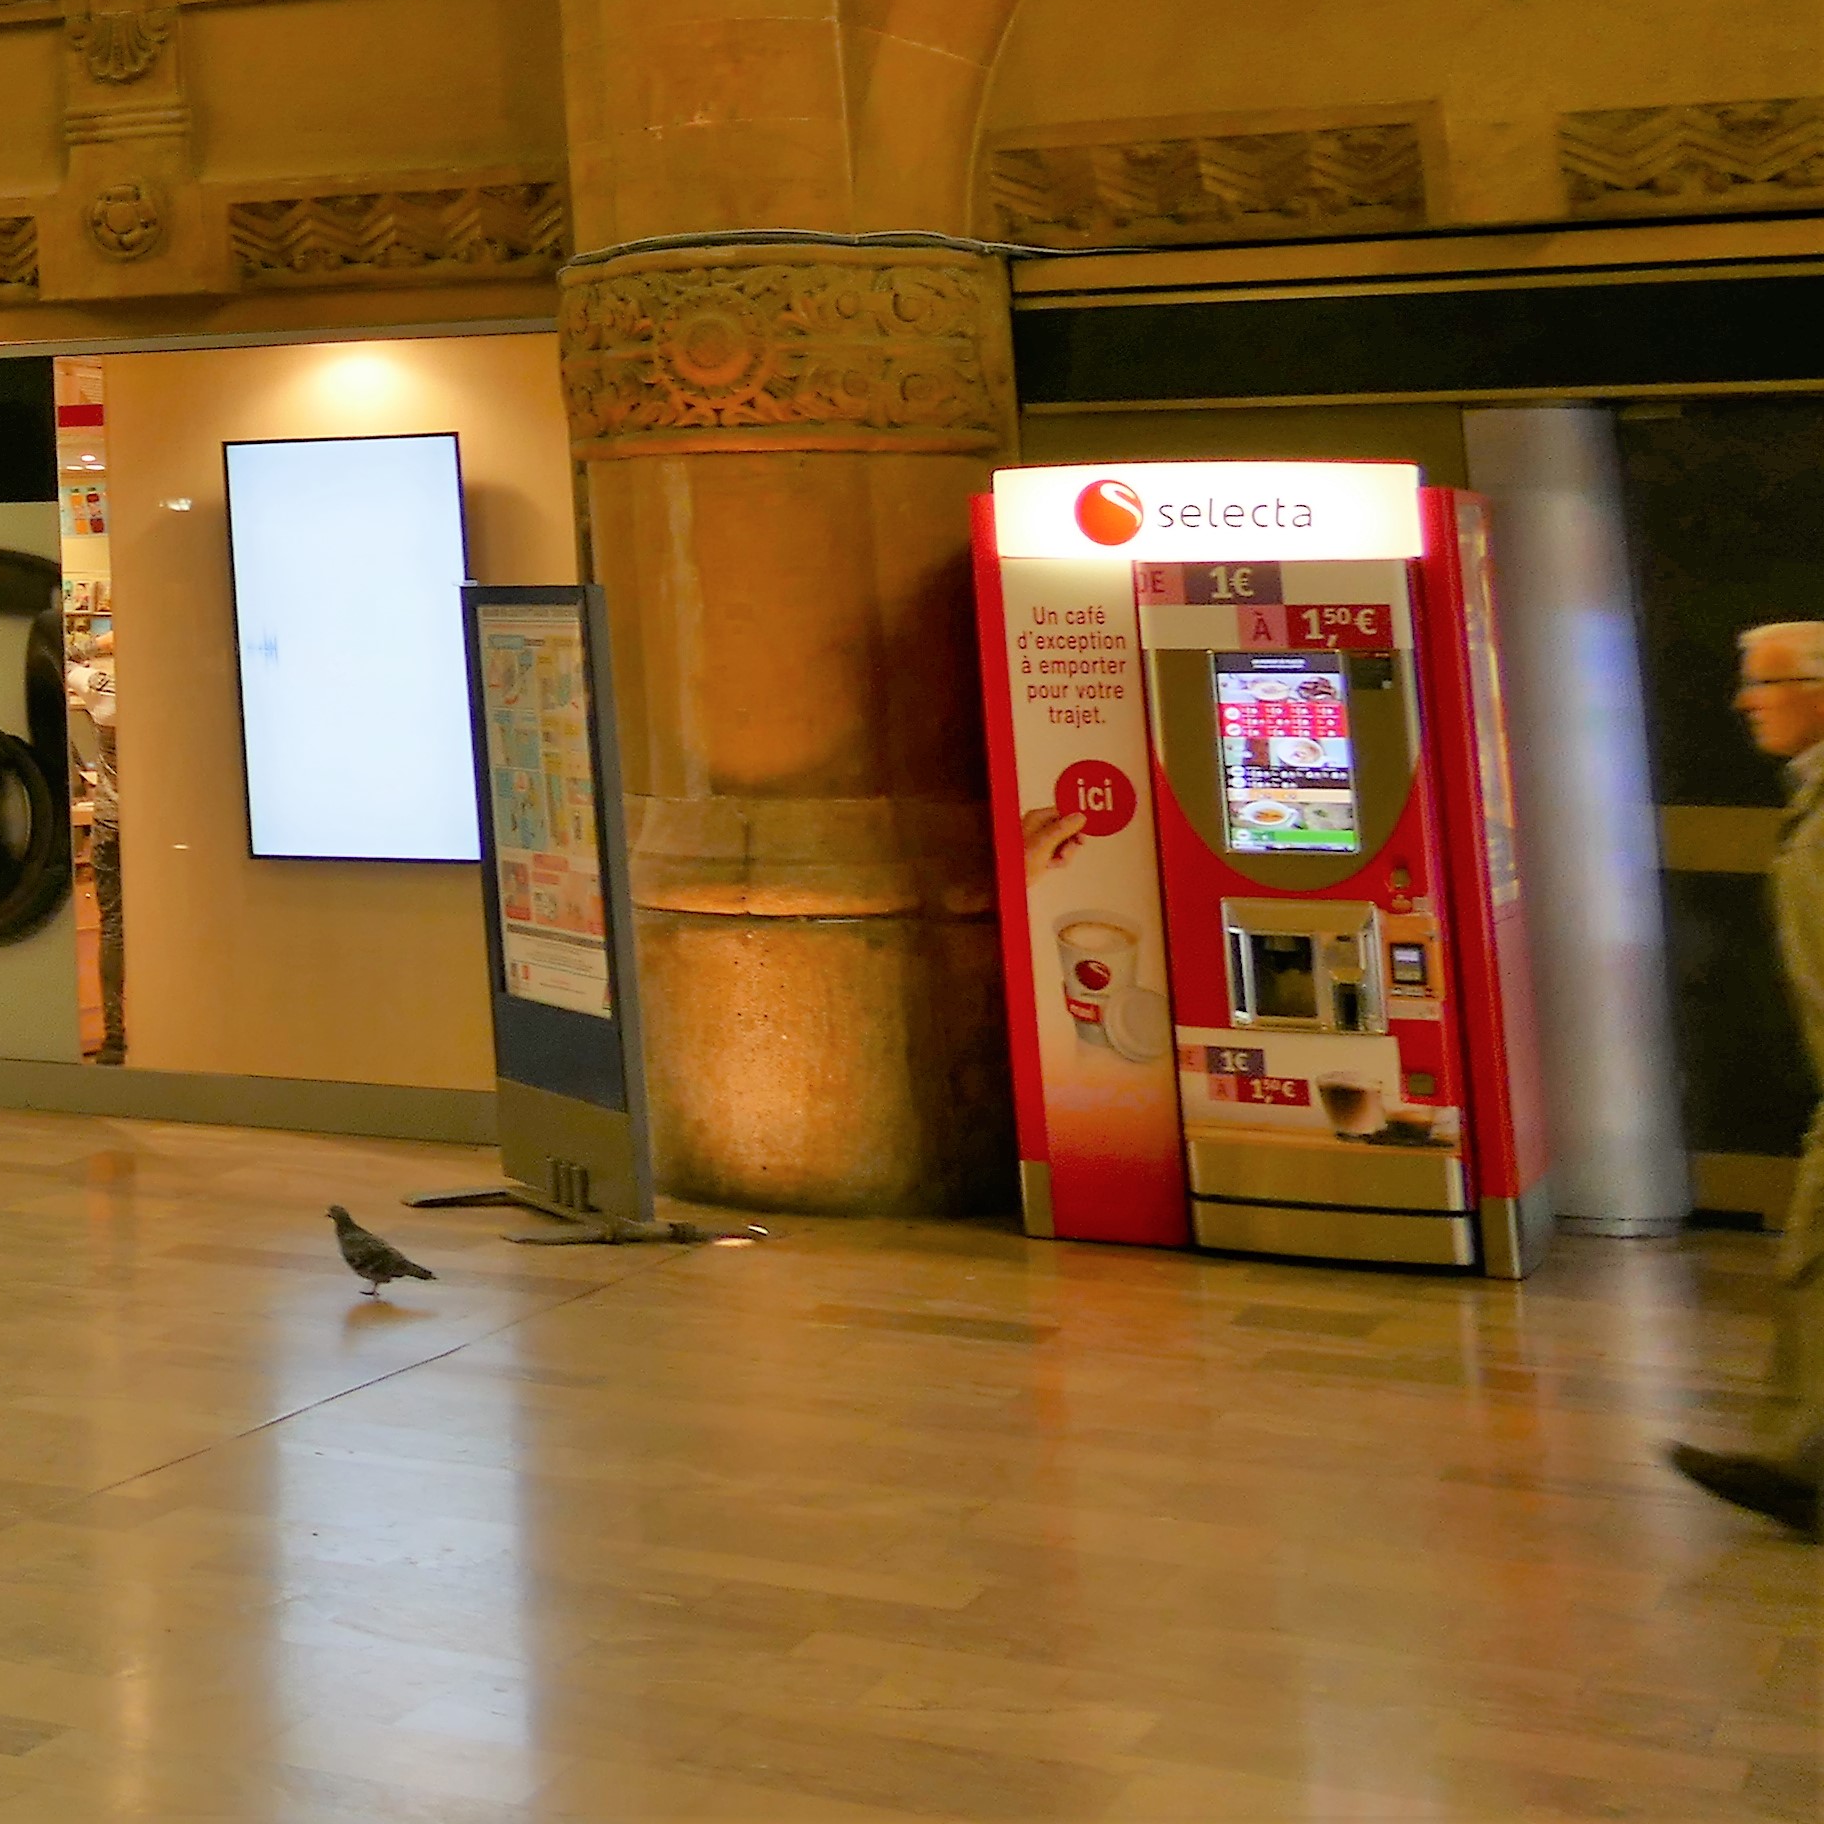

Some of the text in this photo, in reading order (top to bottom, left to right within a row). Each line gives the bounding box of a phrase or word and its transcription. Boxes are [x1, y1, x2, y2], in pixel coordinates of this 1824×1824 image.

[1157, 498, 1313, 529] selecta
[1209, 564, 1255, 600] 1€
[1033, 605, 1106, 625] Un café
[1017, 631, 1126, 654] d'exception
[1021, 655, 1126, 678] à emporter
[1027, 684, 1125, 703] pour votre
[1048, 705, 1106, 728] trajet.
[1076, 778, 1114, 812] ici
